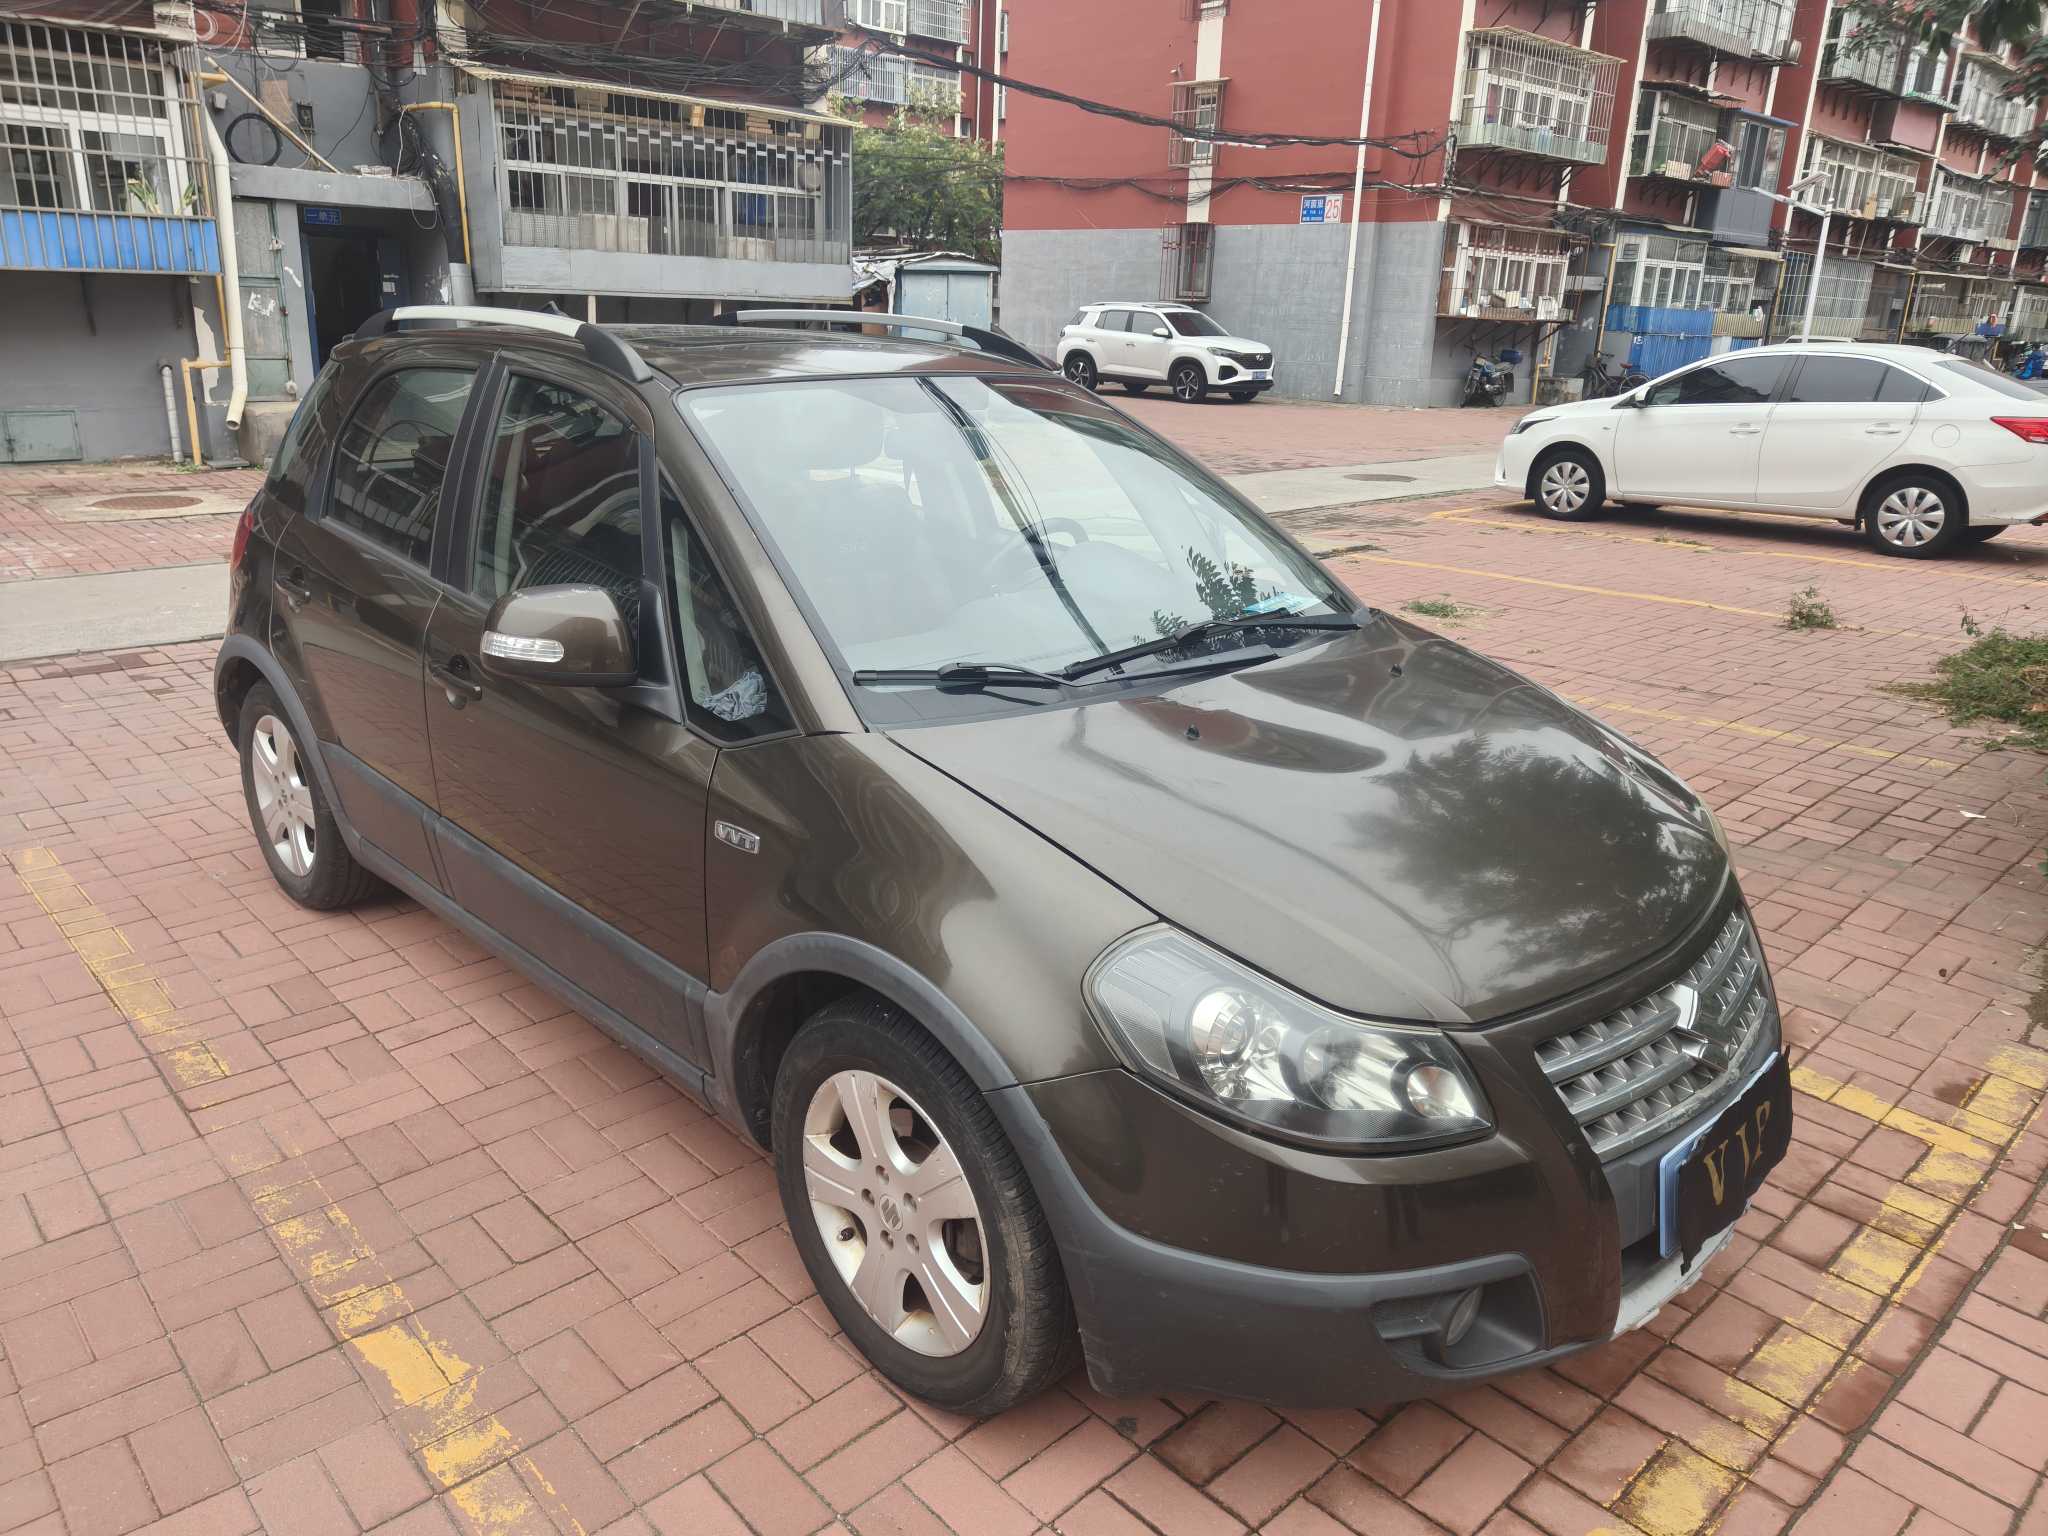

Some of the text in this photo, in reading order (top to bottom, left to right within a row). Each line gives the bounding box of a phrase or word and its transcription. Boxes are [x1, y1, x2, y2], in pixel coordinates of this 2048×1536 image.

[306, 208, 337, 224] 一单元
[717, 823, 755, 849] VVT
[1703, 1100, 1771, 1205] VIP
